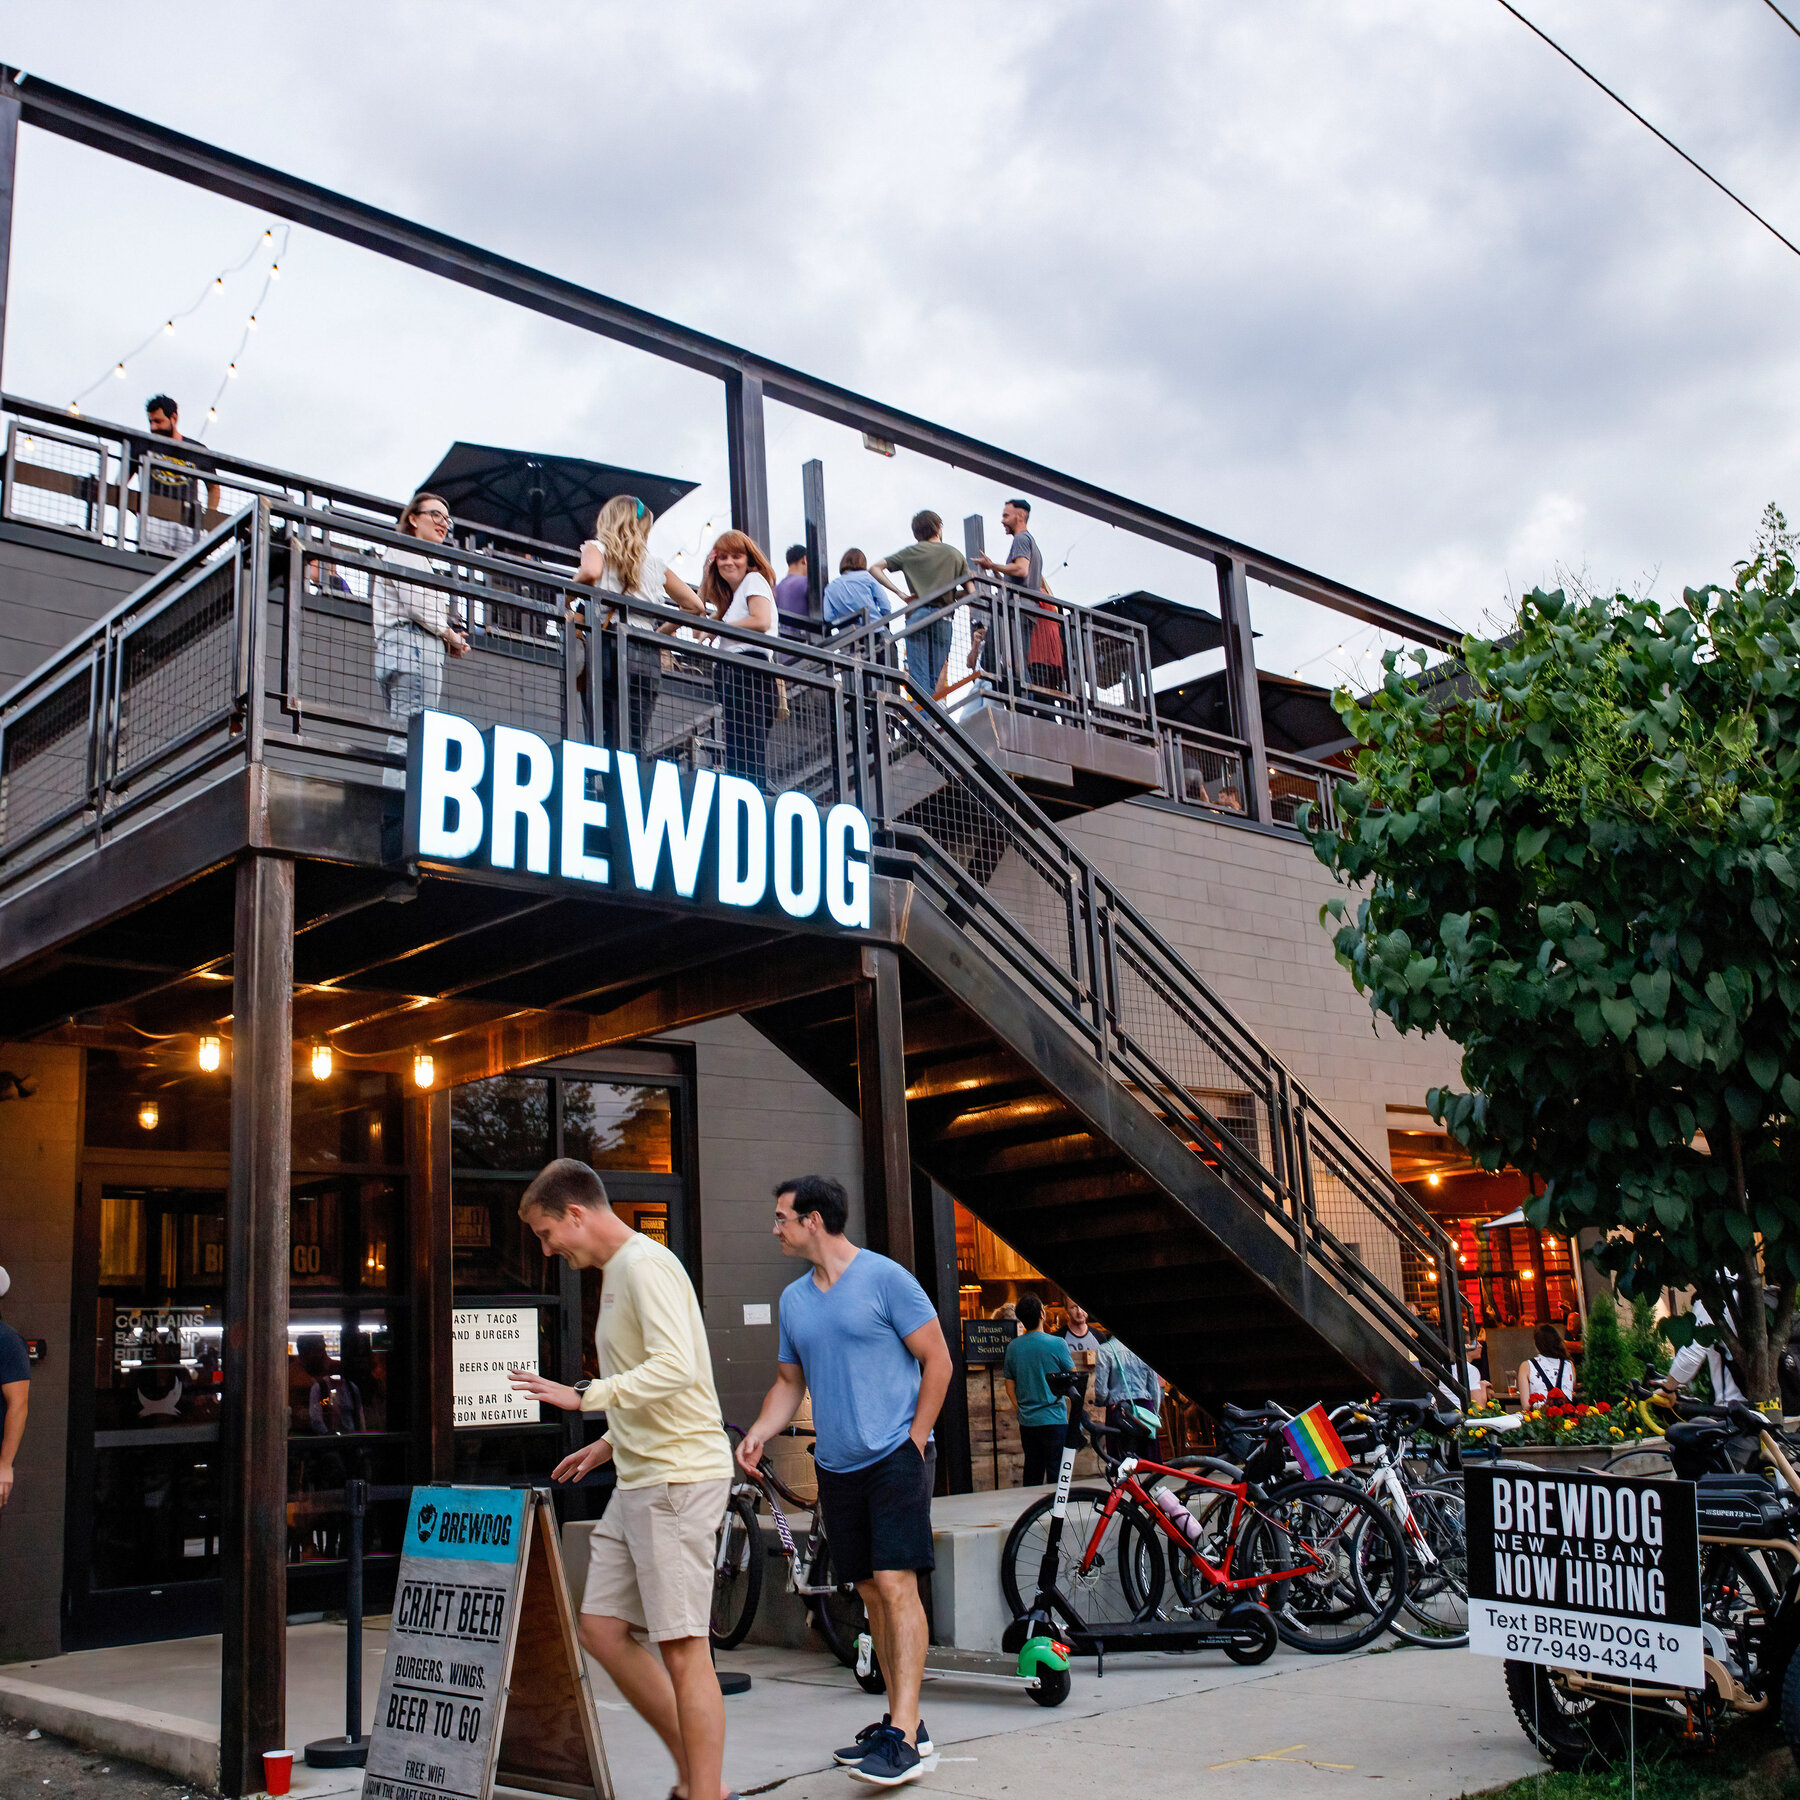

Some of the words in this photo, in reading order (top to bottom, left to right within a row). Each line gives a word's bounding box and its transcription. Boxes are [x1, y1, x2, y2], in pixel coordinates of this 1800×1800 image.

[419, 709, 871, 930] BREWDOG
[115, 1314, 204, 1328] CONTAINS
[453, 1314, 479, 1324] ASTY
[487, 1313, 517, 1324] TACOS
[977, 1326, 1003, 1334] Please
[165, 1330, 201, 1345] AND
[452, 1330, 470, 1340] AND
[475, 1329, 520, 1340] BURGERS
[989, 1335, 999, 1343] To
[459, 1361, 489, 1372] BEERS
[492, 1361, 504, 1371] ON
[507, 1360, 538, 1371] DRAFT
[453, 1395, 473, 1406] THIS
[478, 1394, 497, 1405] BAR
[504, 1393, 513, 1403] IS
[453, 1411, 476, 1422] RBON
[481, 1408, 528, 1420] NEGATIVE
[1056, 1461, 1072, 1504] BIRD
[1492, 1477, 1662, 1546] BREWDOG
[438, 1511, 513, 1546] BREWDOG
[1494, 1532, 1545, 1553] NEW
[1560, 1539, 1663, 1566] ALBANY
[1495, 1551, 1557, 1602] NOW
[1566, 1562, 1666, 1616] HIRING
[398, 1585, 455, 1631] CRAFT
[457, 1591, 505, 1636] BEER
[1485, 1608, 1528, 1631] Text
[1534, 1615, 1651, 1648] BREWDOG
[1657, 1632, 1680, 1653] to
[1506, 1635, 1658, 1673] 877-949-4344
[395, 1655, 444, 1684] BURGERS.
[449, 1662, 486, 1689] WINGS.
[386, 1694, 428, 1734] BEER
[433, 1701, 454, 1739] TO
[458, 1706, 482, 1744] GO
[405, 1760, 426, 1780] FREE
[428, 1764, 446, 1785] WIFI
[366, 1780, 380, 1796] JOIN
[382, 1783, 395, 1799] THE
[396, 1787, 418, 1800] CRAFT
